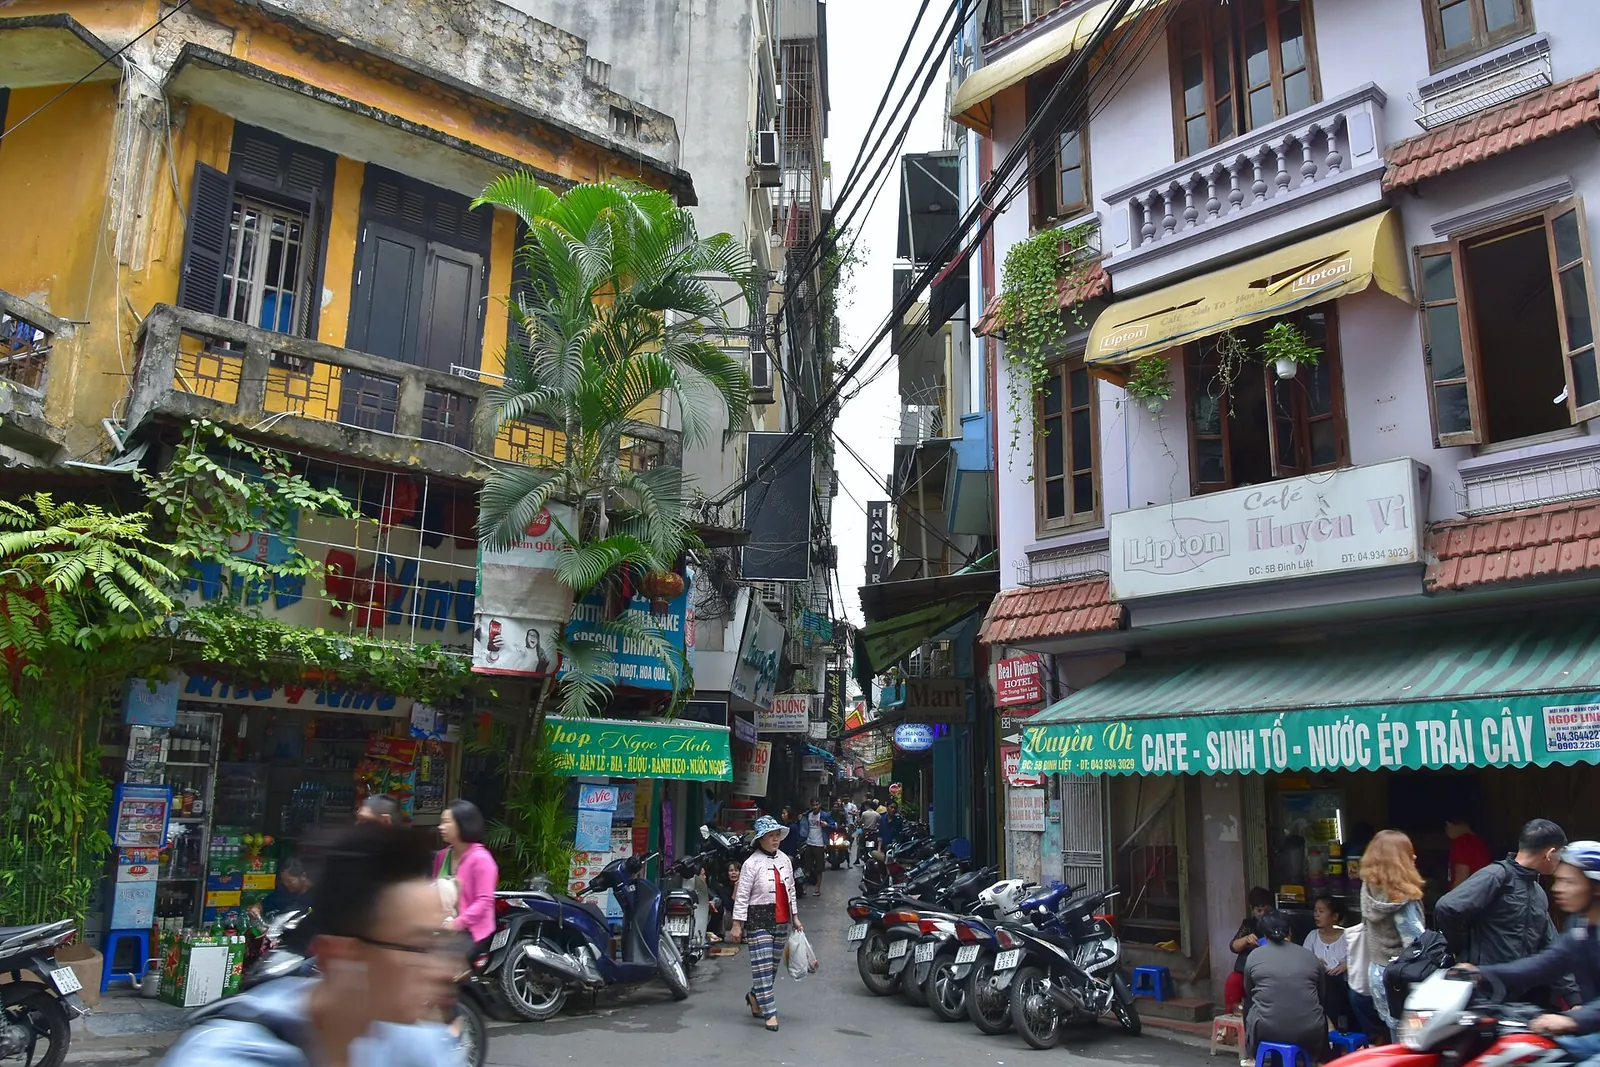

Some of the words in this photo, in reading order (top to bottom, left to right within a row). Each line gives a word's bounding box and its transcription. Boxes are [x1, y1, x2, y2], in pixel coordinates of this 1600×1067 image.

[1298, 262, 1346, 286] Lipton
[1104, 328, 1144, 347] Lipton
[1243, 485, 1303, 512] Café
[870, 508, 883, 564] HANOI
[1247, 495, 1356, 555] Huyền
[1366, 494, 1410, 534] Vi
[1128, 530, 1225, 569] Lipton
[1248, 564, 1264, 576] ĐC:
[1265, 563, 1277, 574] 5B
[1298, 558, 1314, 572] Liệt
[1341, 552, 1356, 564] ĐT:
[1357, 549, 1386, 562] 04.934
[1387, 546, 1410, 559] 3029
[639, 664, 652, 680] HOA
[997, 661, 1013, 680] Real
[1013, 660, 1039, 677] Vietnam
[908, 683, 962, 707] Mart
[1004, 677, 1033, 689] HOTEL
[1548, 714, 1578, 725] NGỌC
[597, 731, 658, 754] Ngọc
[1024, 723, 1095, 758] Huyền
[1102, 722, 1135, 751] Vi
[1141, 732, 1189, 772] CAFE
[1206, 729, 1256, 771] SINH
[1259, 713, 1288, 769] TỐ
[1307, 714, 1371, 767] NƯỚC
[1376, 713, 1409, 765] ÉP
[1415, 709, 1475, 764] TRÁI
[1481, 706, 1534, 763] CÂY
[610, 756, 623, 772] BIA
[755, 745, 768, 764] BÒ
[1057, 758, 1072, 772] LIỆT
[1090, 759, 1103, 770] 043
[1104, 758, 1117, 770] 934
[1117, 758, 1135, 770] 3029
[224, 952, 235, 988] Heineken
